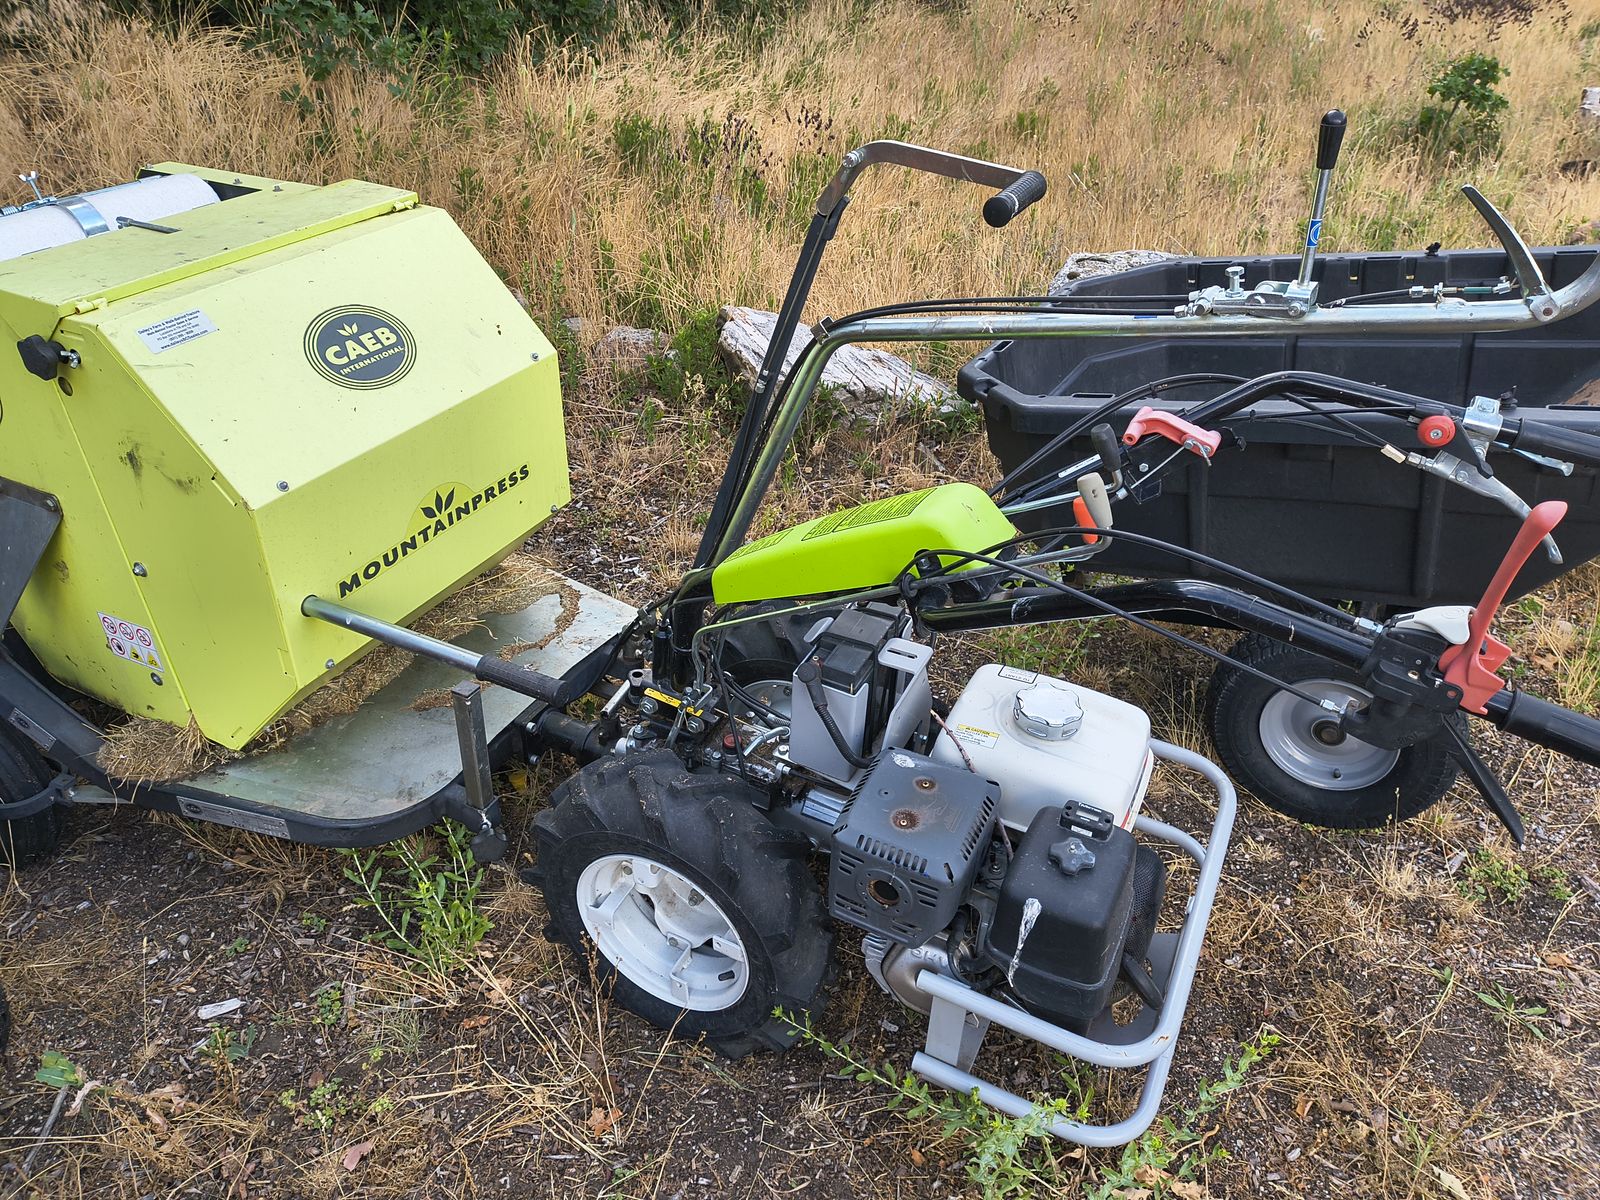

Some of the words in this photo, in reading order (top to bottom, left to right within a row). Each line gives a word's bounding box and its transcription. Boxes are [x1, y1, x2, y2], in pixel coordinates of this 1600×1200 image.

[325, 327, 397, 365] CAEB
[340, 345, 404, 375] INTERNATIONAL
[338, 464, 530, 598] MOUNTAINPRESS
